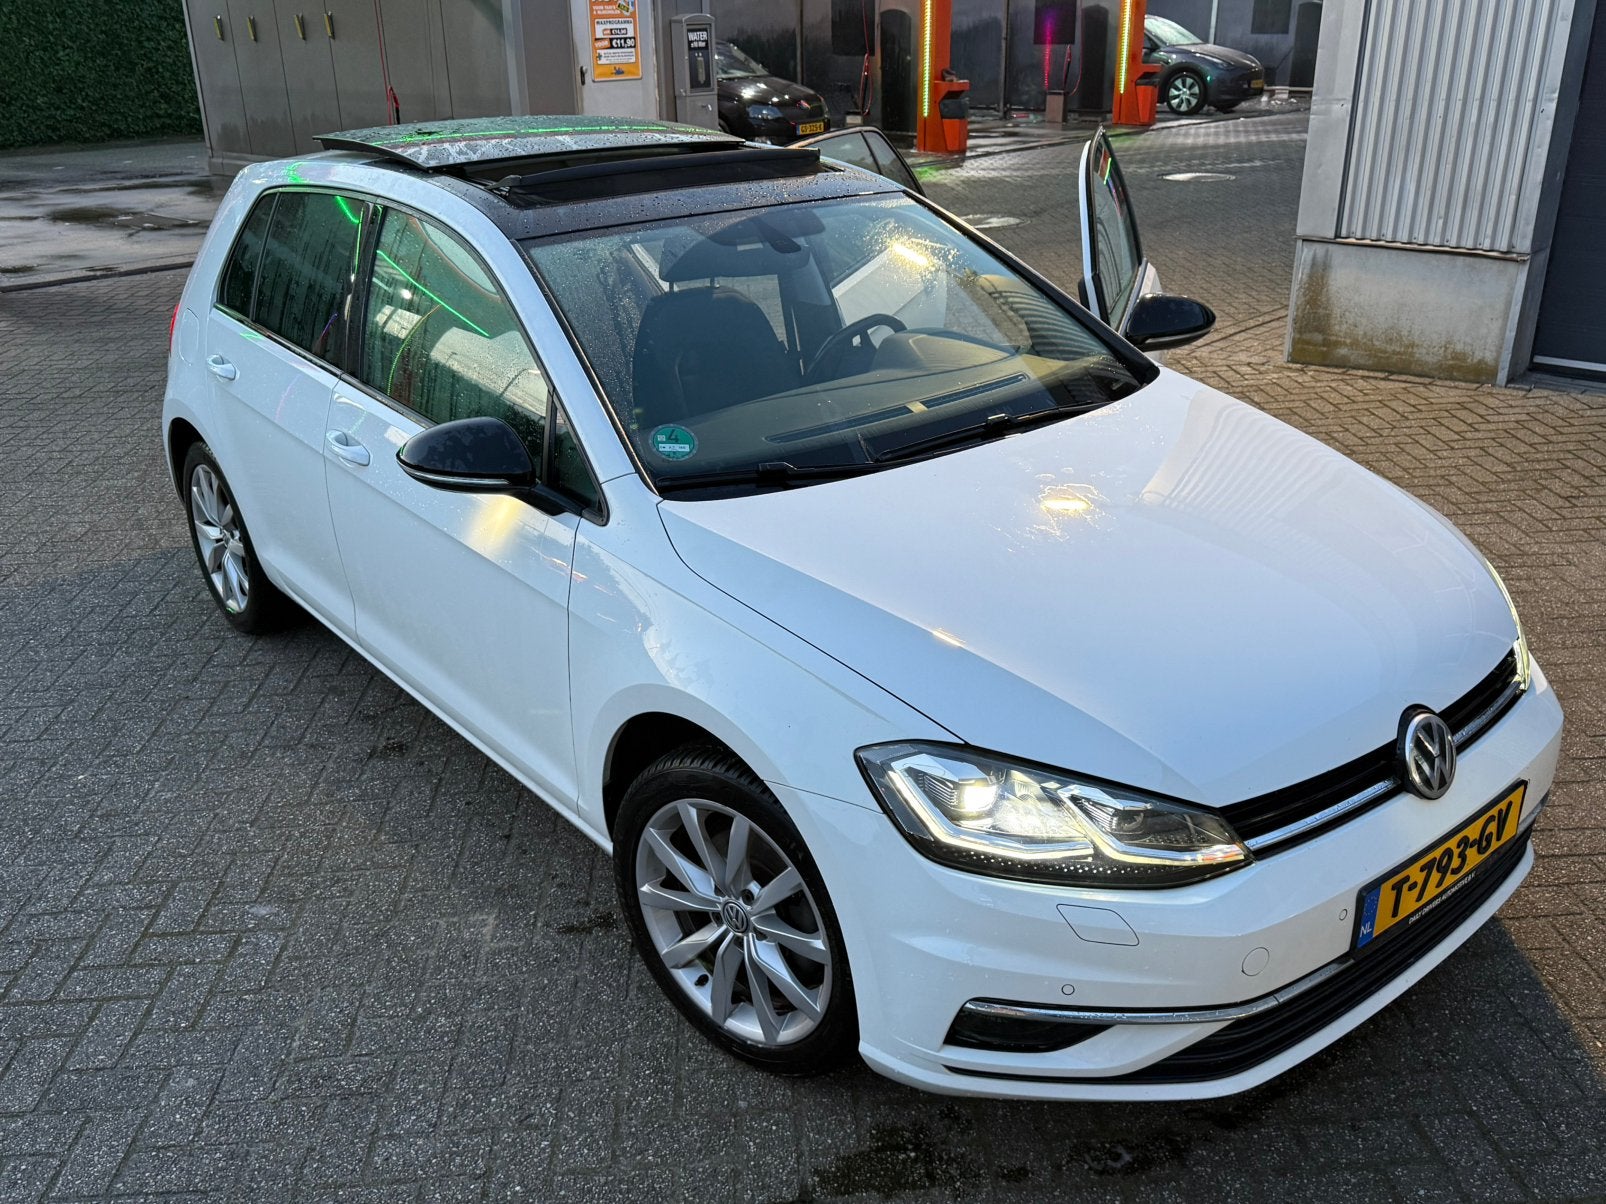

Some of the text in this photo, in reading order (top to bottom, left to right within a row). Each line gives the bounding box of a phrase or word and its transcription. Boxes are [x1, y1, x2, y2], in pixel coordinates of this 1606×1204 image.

[687, 31, 708, 41] WATER
[612, 39, 635, 48] €11,90
[668, 429, 680, 443] 4
[1391, 801, 1513, 918] T-793-GV
[1360, 921, 1373, 938] NL
